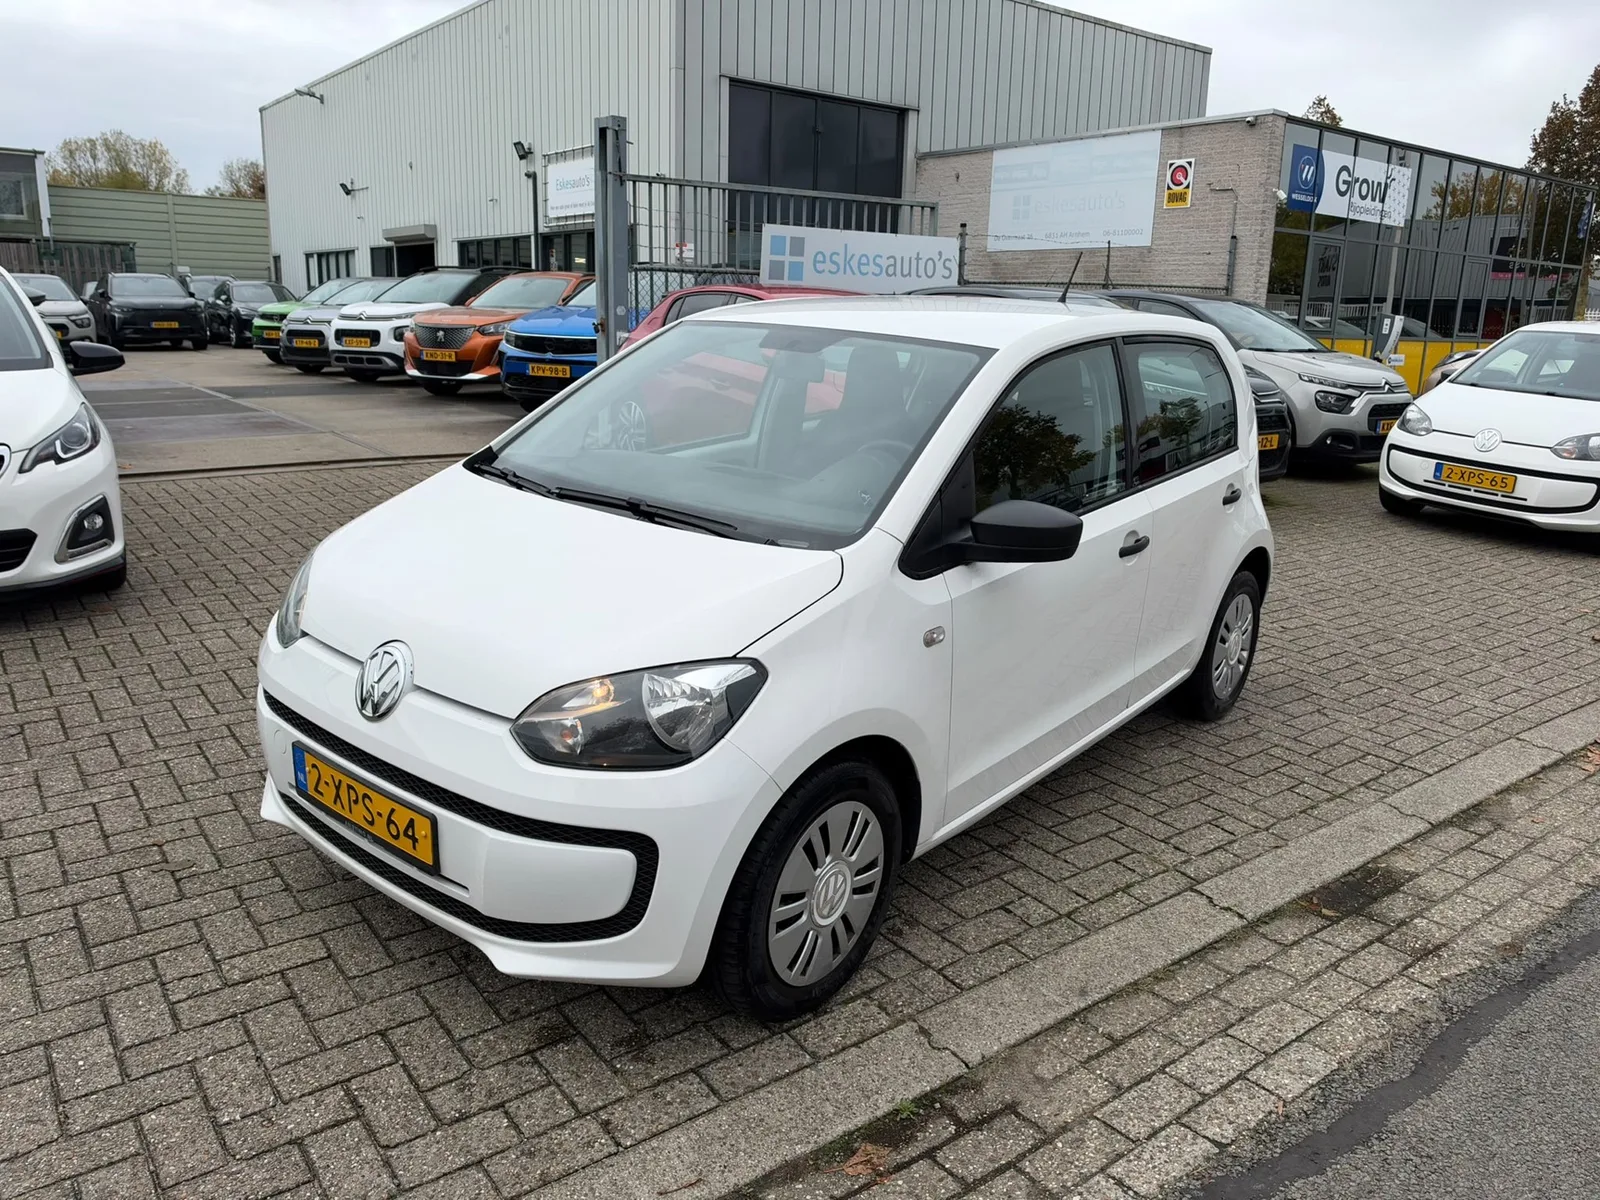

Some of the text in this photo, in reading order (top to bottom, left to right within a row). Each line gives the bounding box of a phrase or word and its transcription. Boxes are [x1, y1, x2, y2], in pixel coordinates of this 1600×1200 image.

[555, 176, 590, 191] Eskesauto's
[1167, 191, 1187, 203] BOVAG
[812, 243, 953, 280] eskesauto's
[425, 351, 453, 360] KND-31-R
[531, 365, 567, 376] KPV-98-B
[1446, 467, 1508, 489] 2-XPS-65
[297, 771, 306, 784] NL
[310, 763, 419, 852] 2-XPS-64
